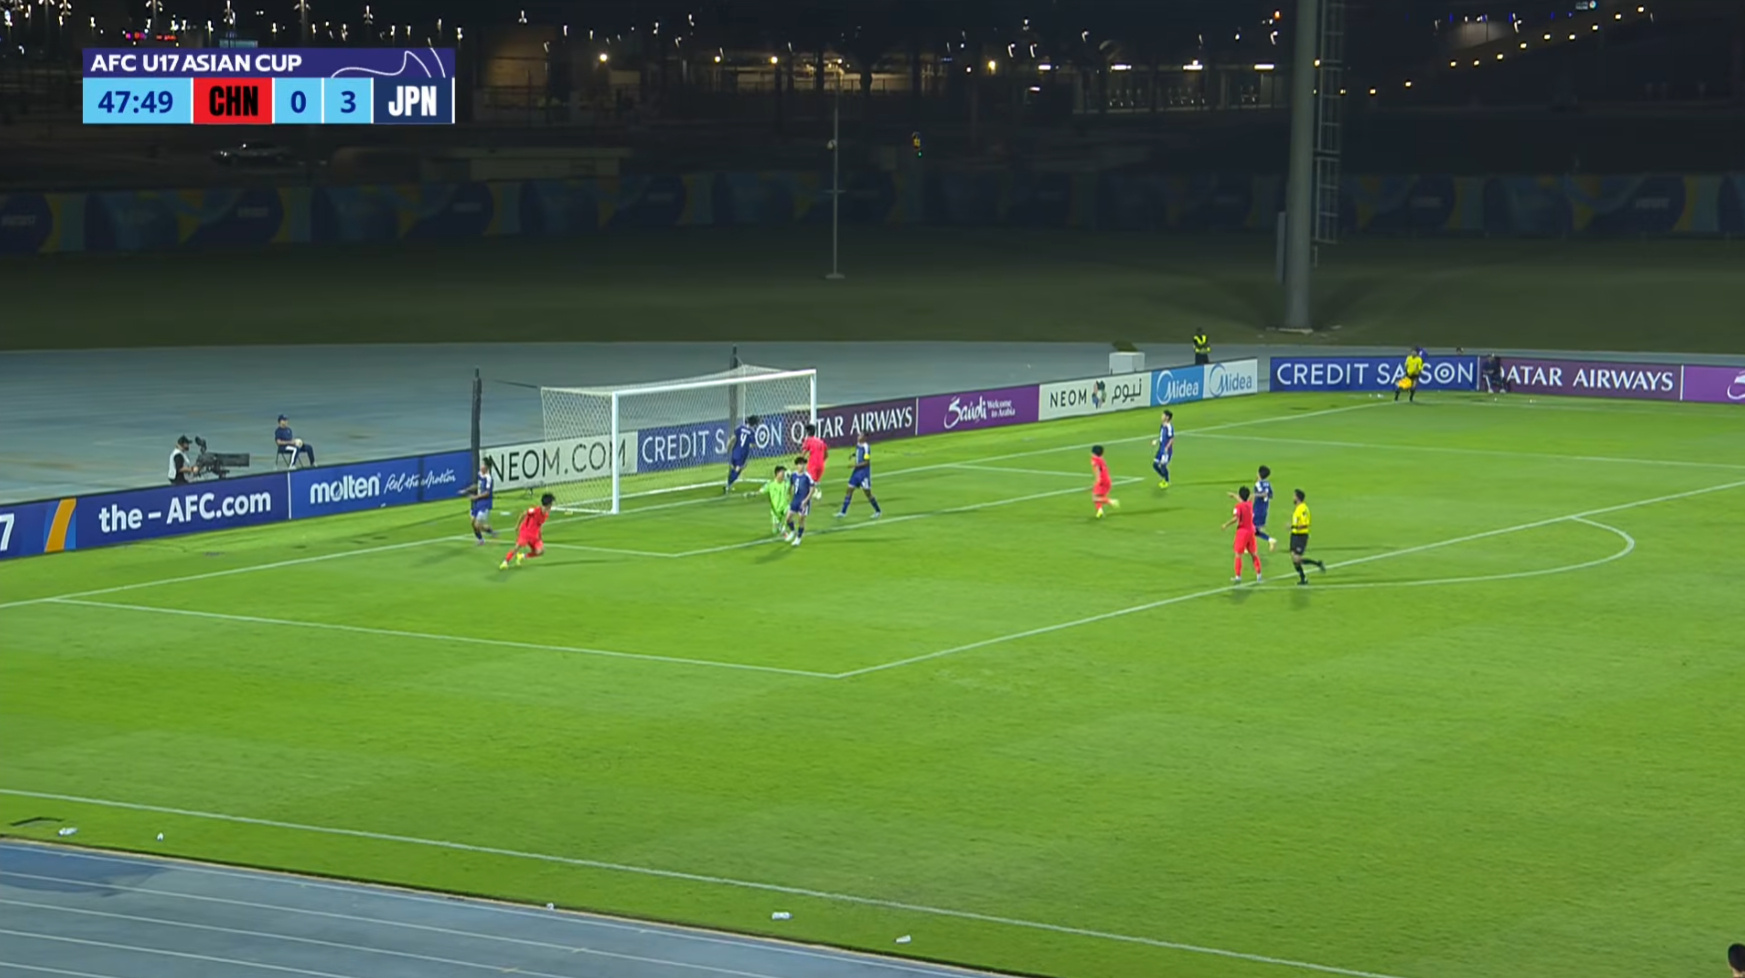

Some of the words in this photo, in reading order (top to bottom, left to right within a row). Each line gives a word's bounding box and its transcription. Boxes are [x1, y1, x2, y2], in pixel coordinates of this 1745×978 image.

[1213, 369, 1253, 395] Midea
[1276, 362, 1370, 386] CREDIT
[1377, 360, 1474, 386] SASON
[1500, 364, 1563, 387] ATAR
[1573, 368, 1673, 392] AIRWAYS
[1050, 387, 1087, 409] NEOM
[1111, 378, 1143, 406] نيوم
[1161, 376, 1200, 401] Midea
[791, 414, 844, 444] QTAR
[850, 406, 913, 436] AIRWAYS
[943, 395, 987, 429] Saudi
[488, 438, 626, 483] NEOM.COM
[641, 430, 710, 464] CREDIT
[310, 474, 380, 505] molten
[98, 504, 143, 533] the
[166, 491, 272, 525] AFC.com
